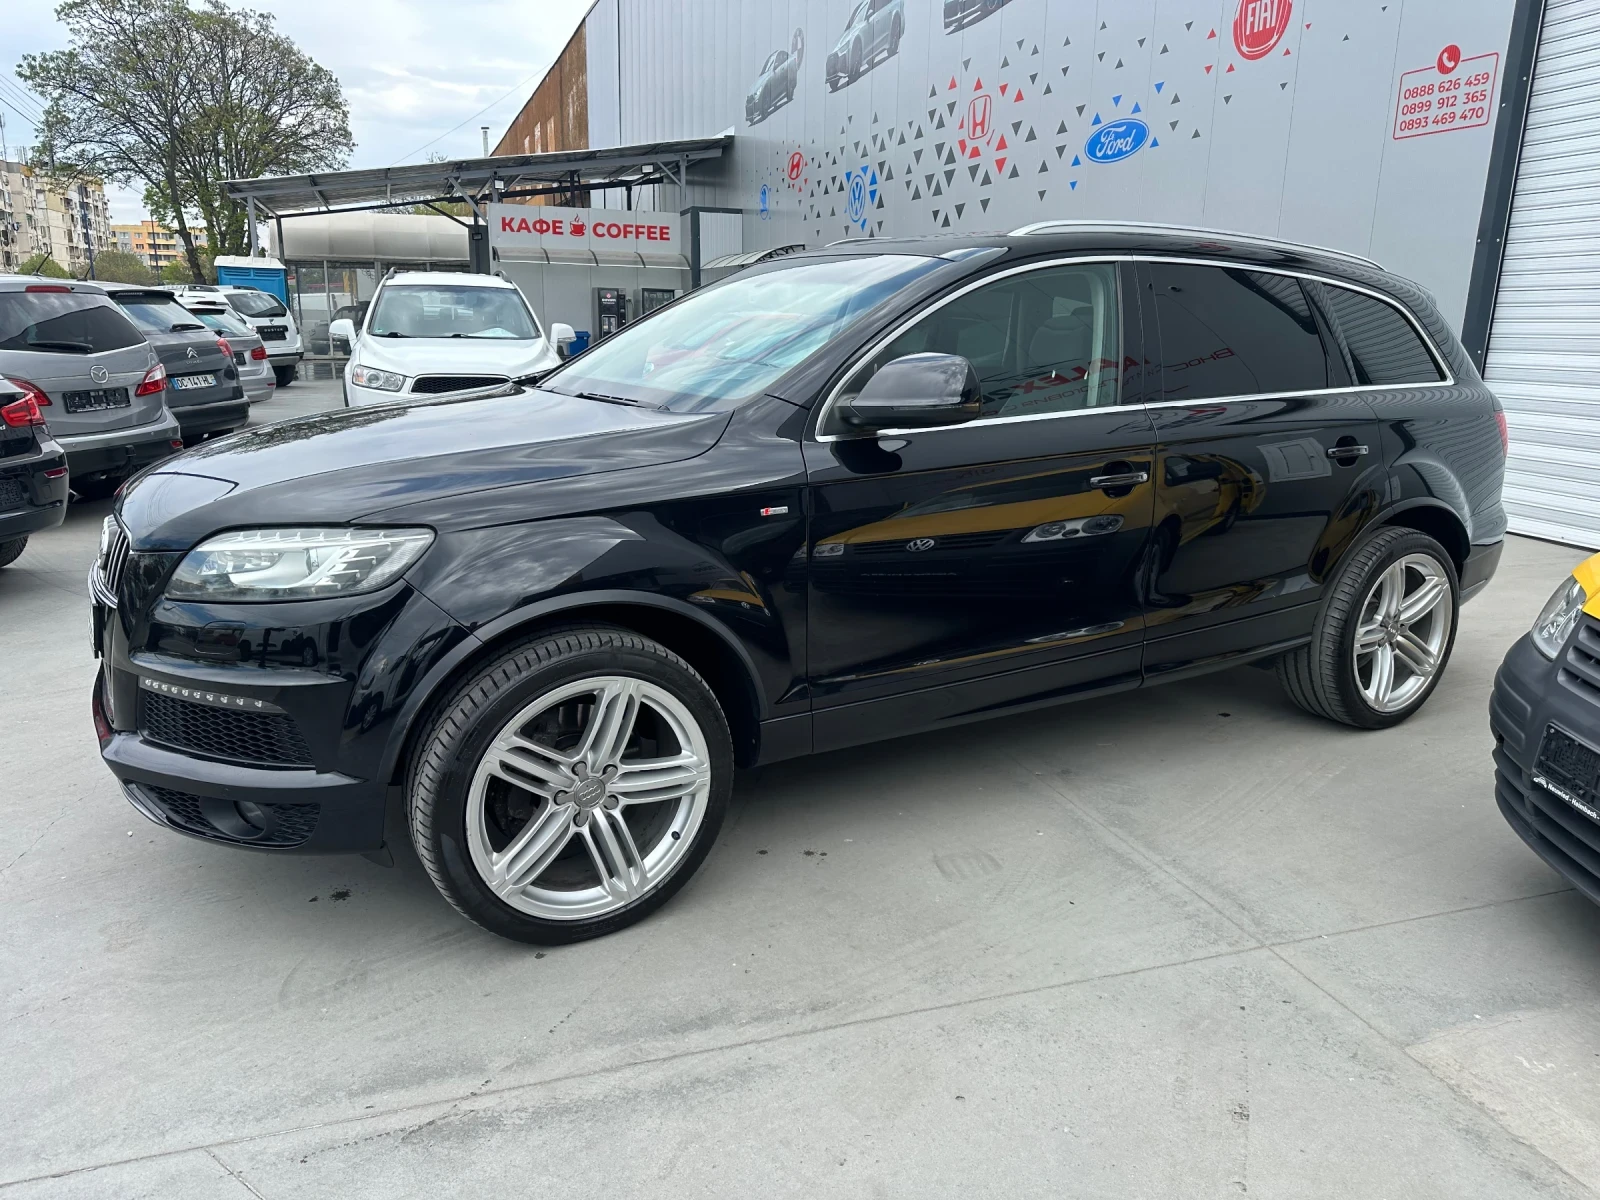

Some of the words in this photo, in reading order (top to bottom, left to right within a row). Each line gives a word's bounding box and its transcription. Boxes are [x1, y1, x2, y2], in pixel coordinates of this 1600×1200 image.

[1246, 0, 1278, 35] FIAT
[1404, 84, 1434, 100] 0888
[1438, 78, 1461, 93] 626
[1464, 72, 1490, 87] 459
[1402, 100, 1432, 116] 0899
[1437, 95, 1457, 110] 912
[1462, 89, 1487, 105] 365
[1399, 116, 1429, 132] 0893
[1432, 111, 1456, 126] 469
[1459, 106, 1484, 121] 470
[1095, 124, 1137, 158] Ford
[501, 216, 564, 235] КАФЕ
[592, 222, 671, 241] COFFEE
